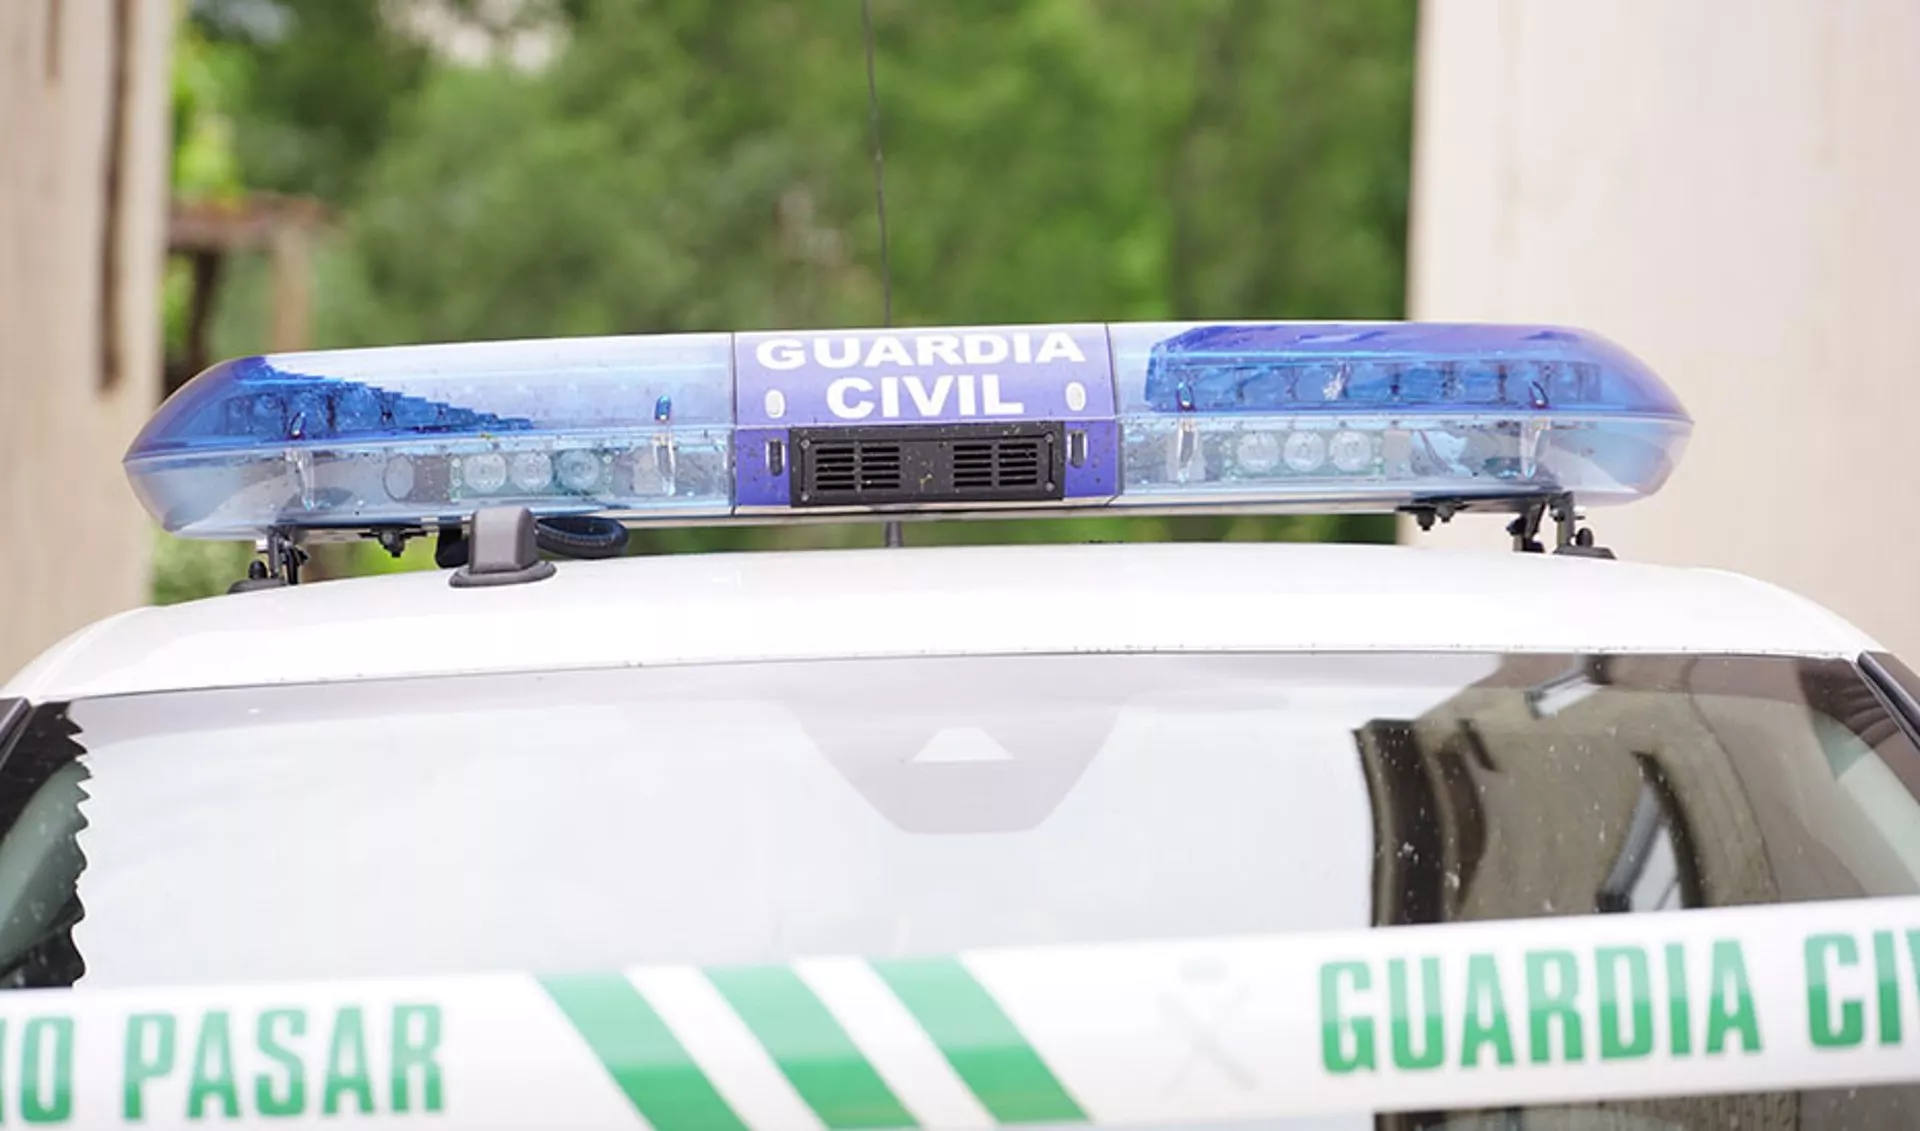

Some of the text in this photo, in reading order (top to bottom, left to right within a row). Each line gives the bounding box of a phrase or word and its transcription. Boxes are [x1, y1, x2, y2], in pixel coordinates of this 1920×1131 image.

[756, 332, 1086, 370] GUARDIA
[826, 374, 1025, 419] CIVIL
[1319, 930, 1920, 1074] GUARDIA CI
[0, 1004, 445, 1124] O PASAR
